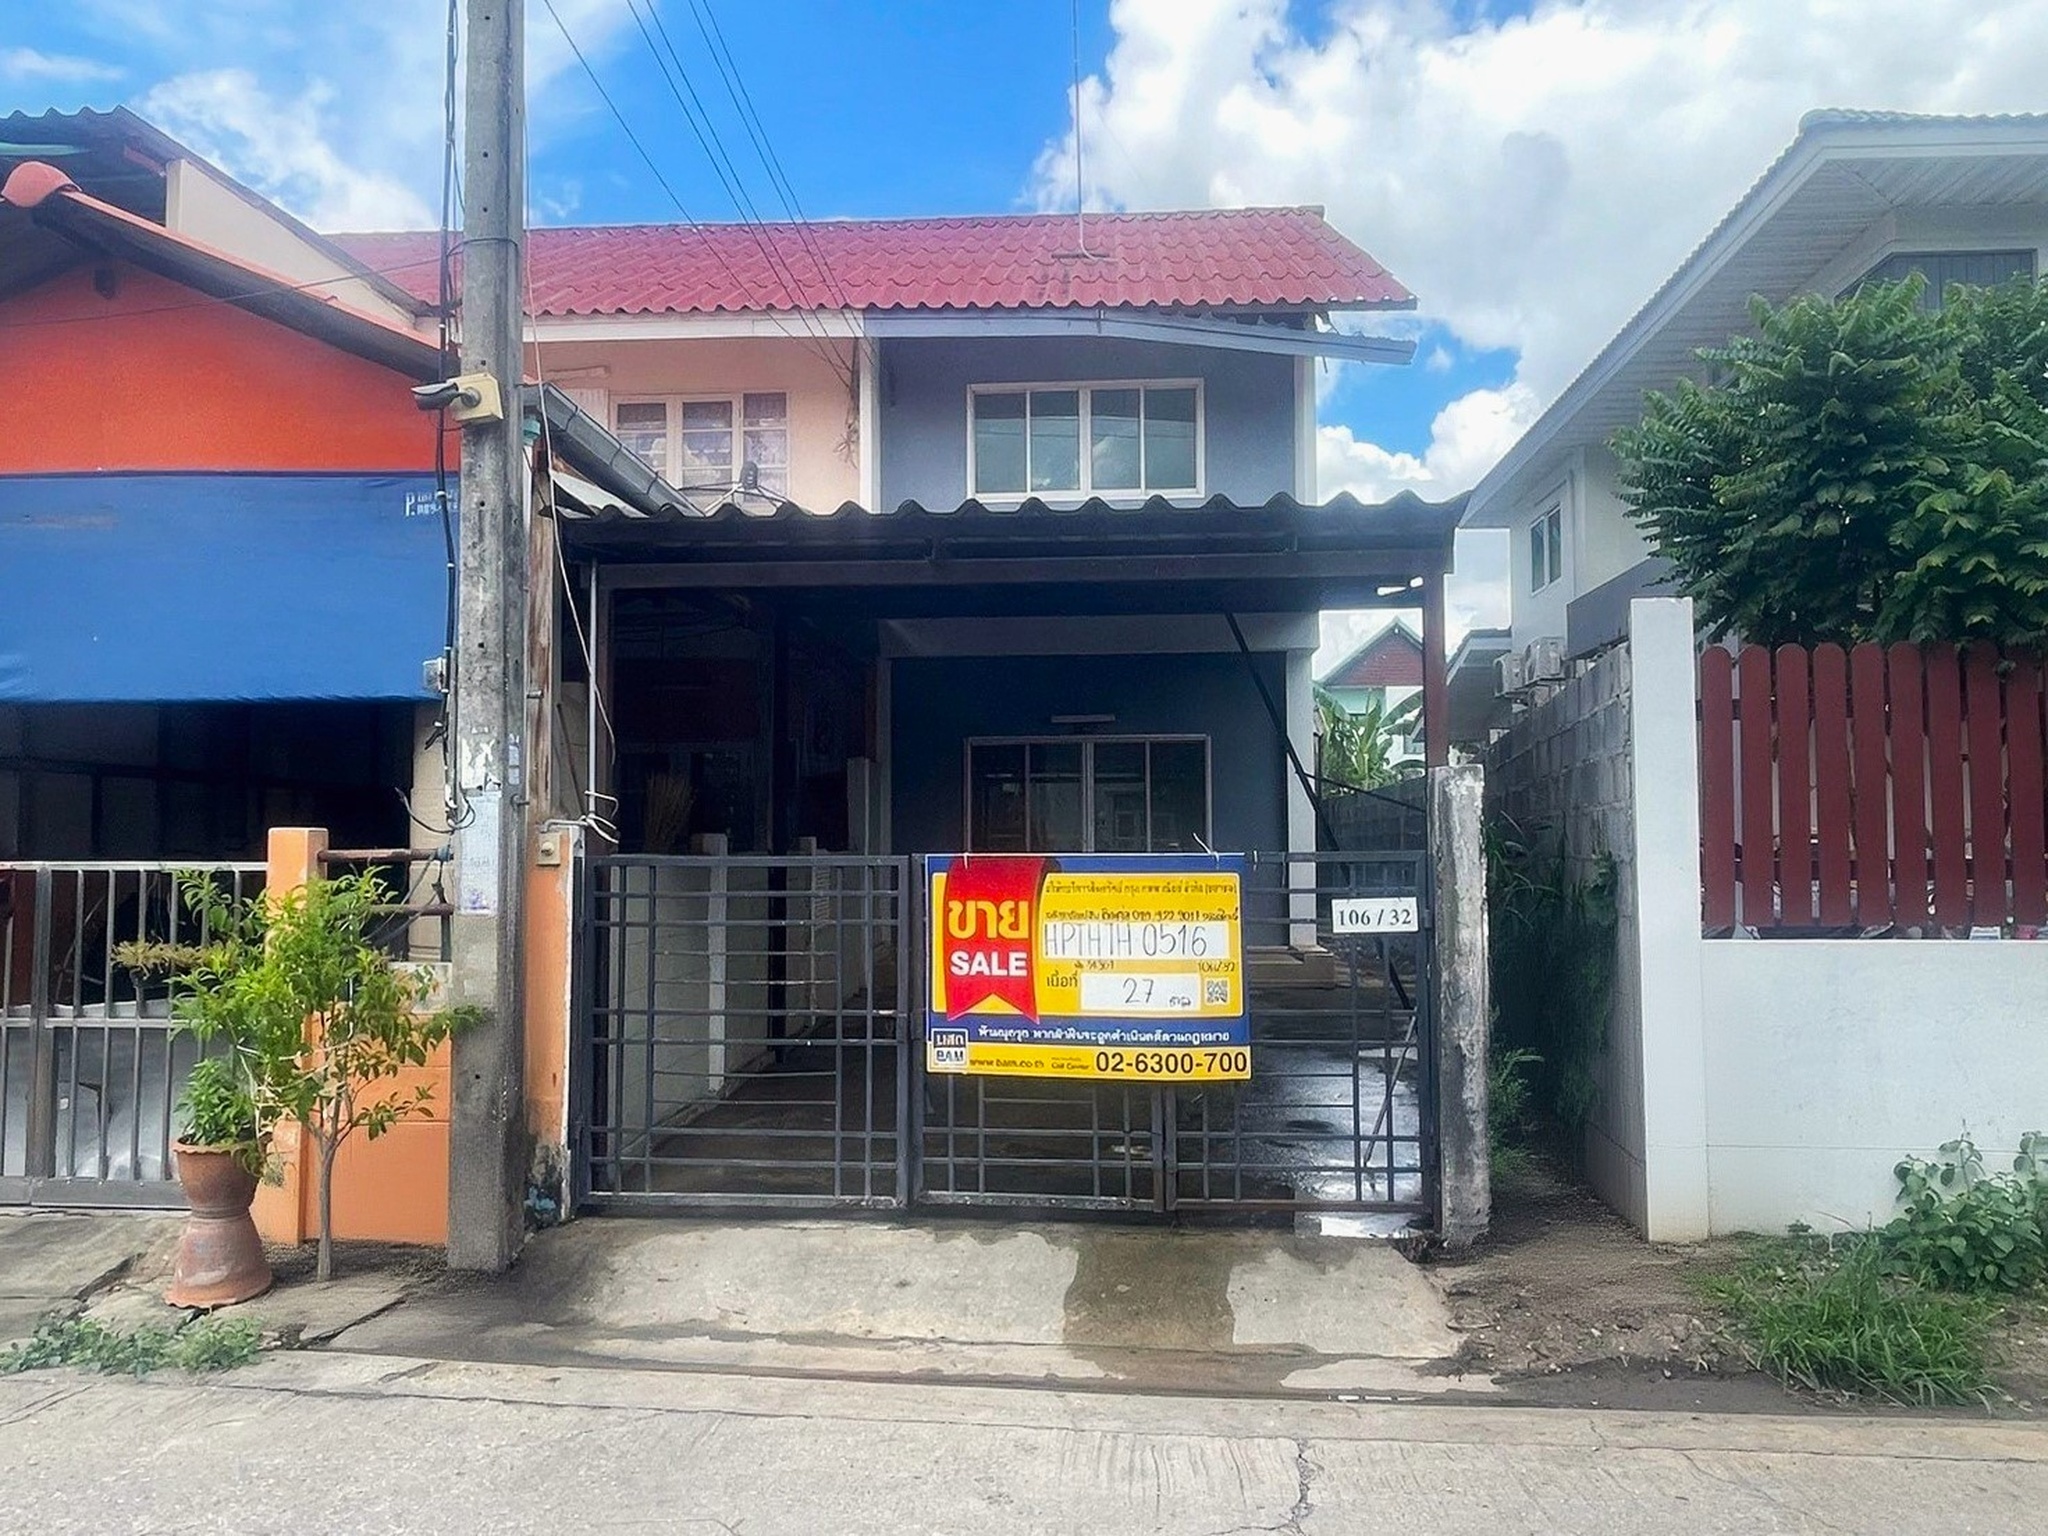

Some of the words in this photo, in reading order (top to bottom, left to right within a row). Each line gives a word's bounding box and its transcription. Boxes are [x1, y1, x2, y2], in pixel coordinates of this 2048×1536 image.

[948, 900, 1029, 939] ขาย
[1142, 923, 1208, 957] 0516
[950, 950, 1028, 977] SALE
[1122, 977, 1154, 1004] 27
[1096, 1051, 1248, 1074] 02-6300-700
